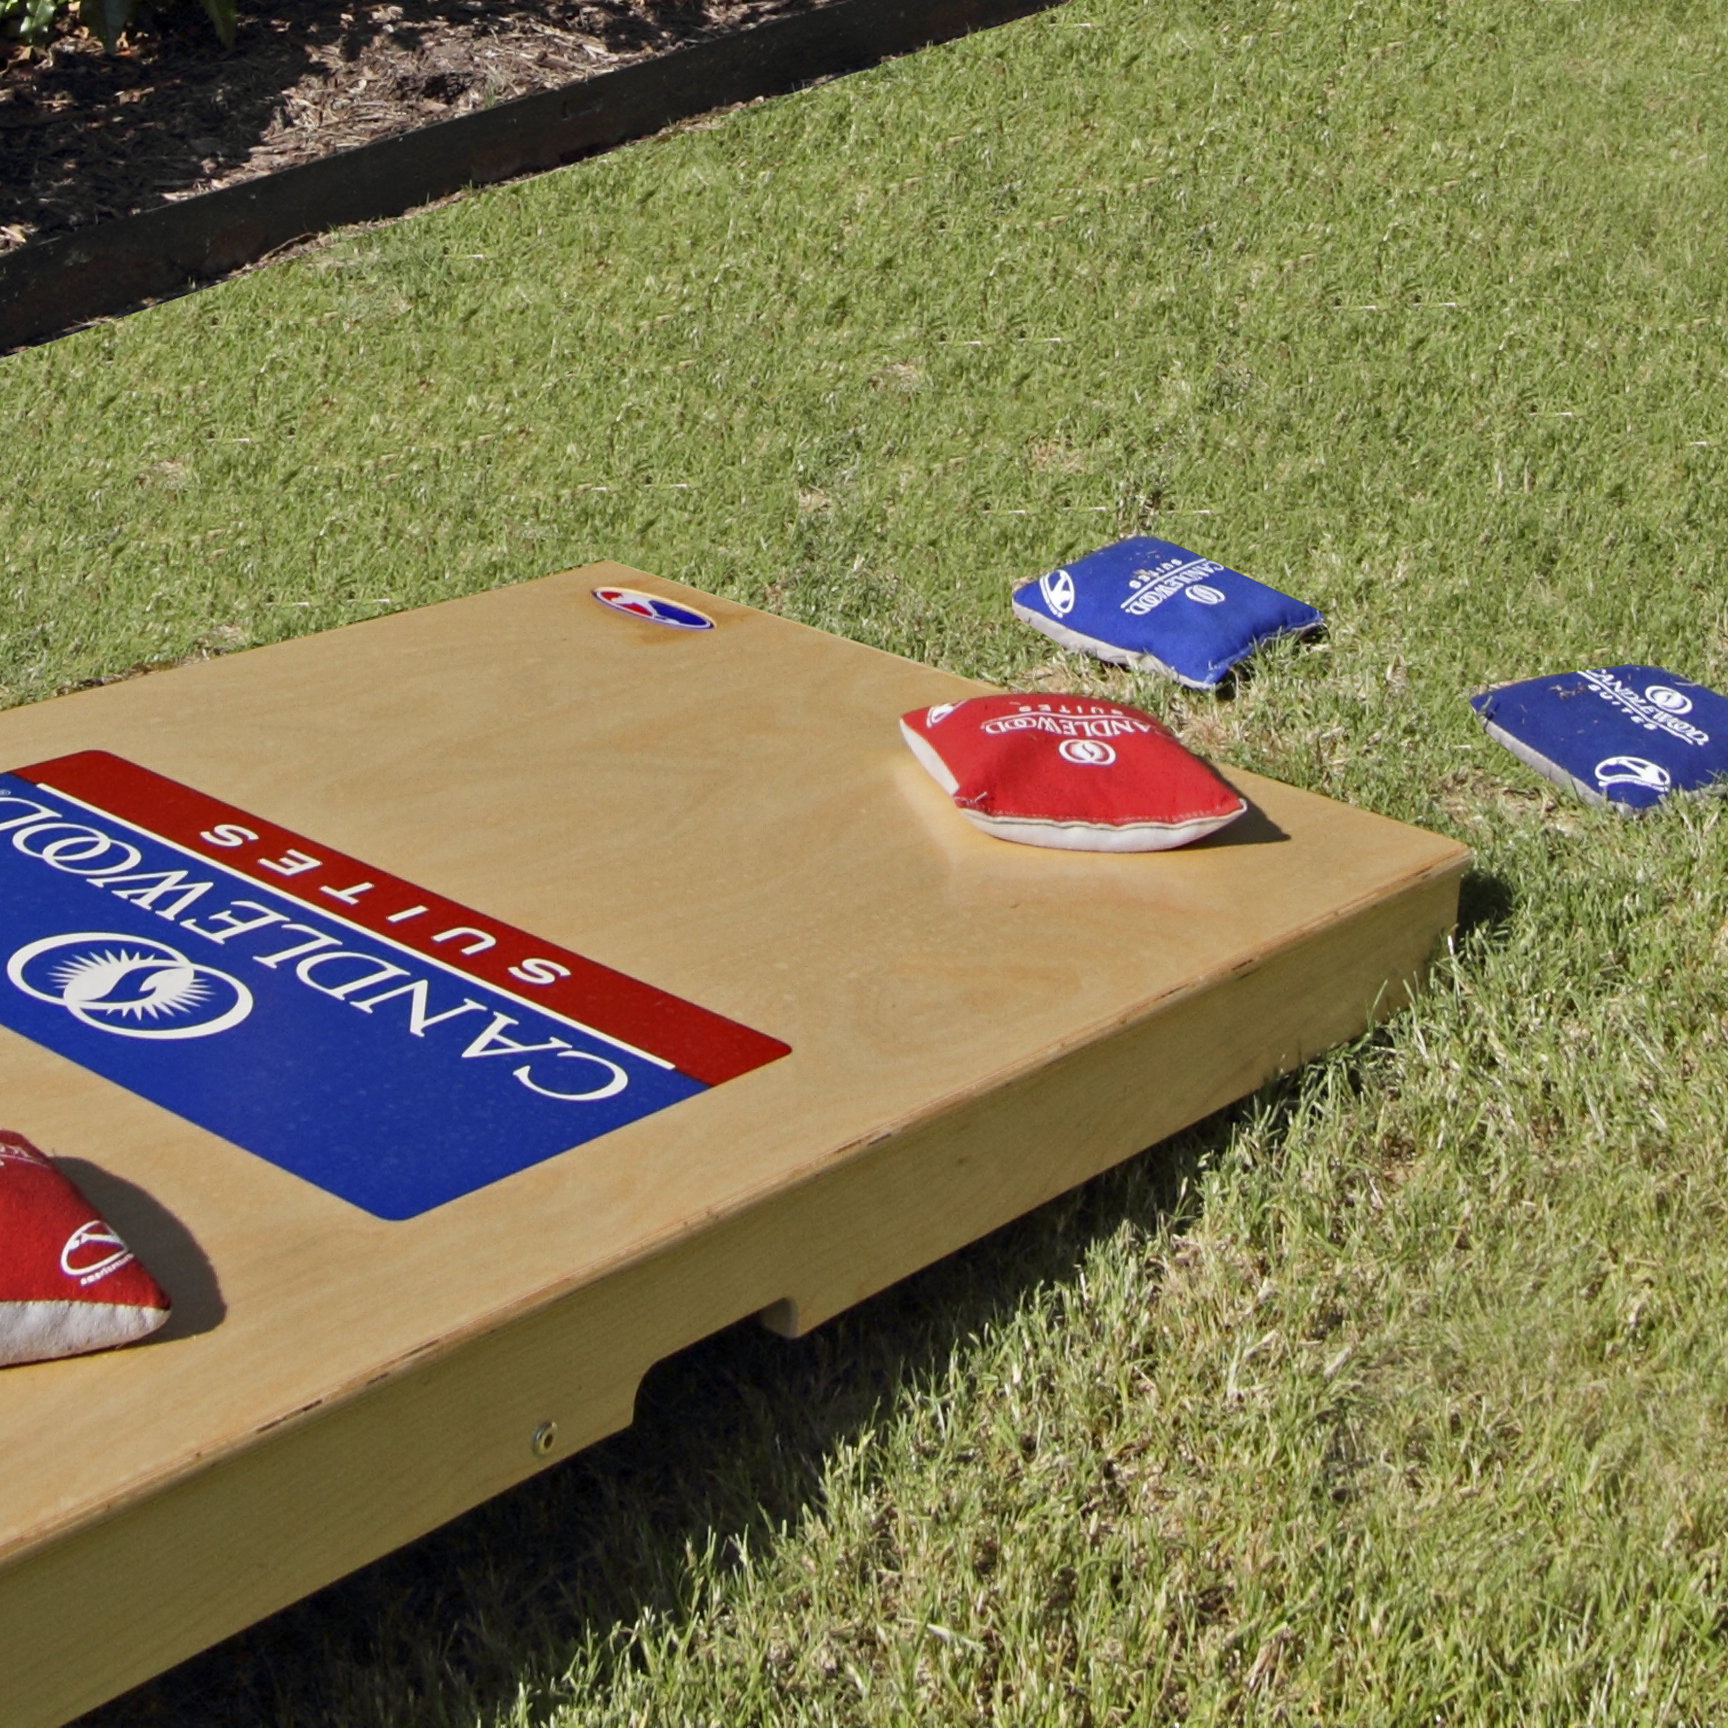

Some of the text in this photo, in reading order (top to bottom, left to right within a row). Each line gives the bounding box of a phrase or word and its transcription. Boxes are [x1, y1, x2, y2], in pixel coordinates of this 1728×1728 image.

[1018, 703, 1124, 716] SUITES
[1587, 683, 1658, 730] SUITES
[985, 715, 1157, 738] ANDLEWOOD
[199, 822, 570, 987] SUITES
